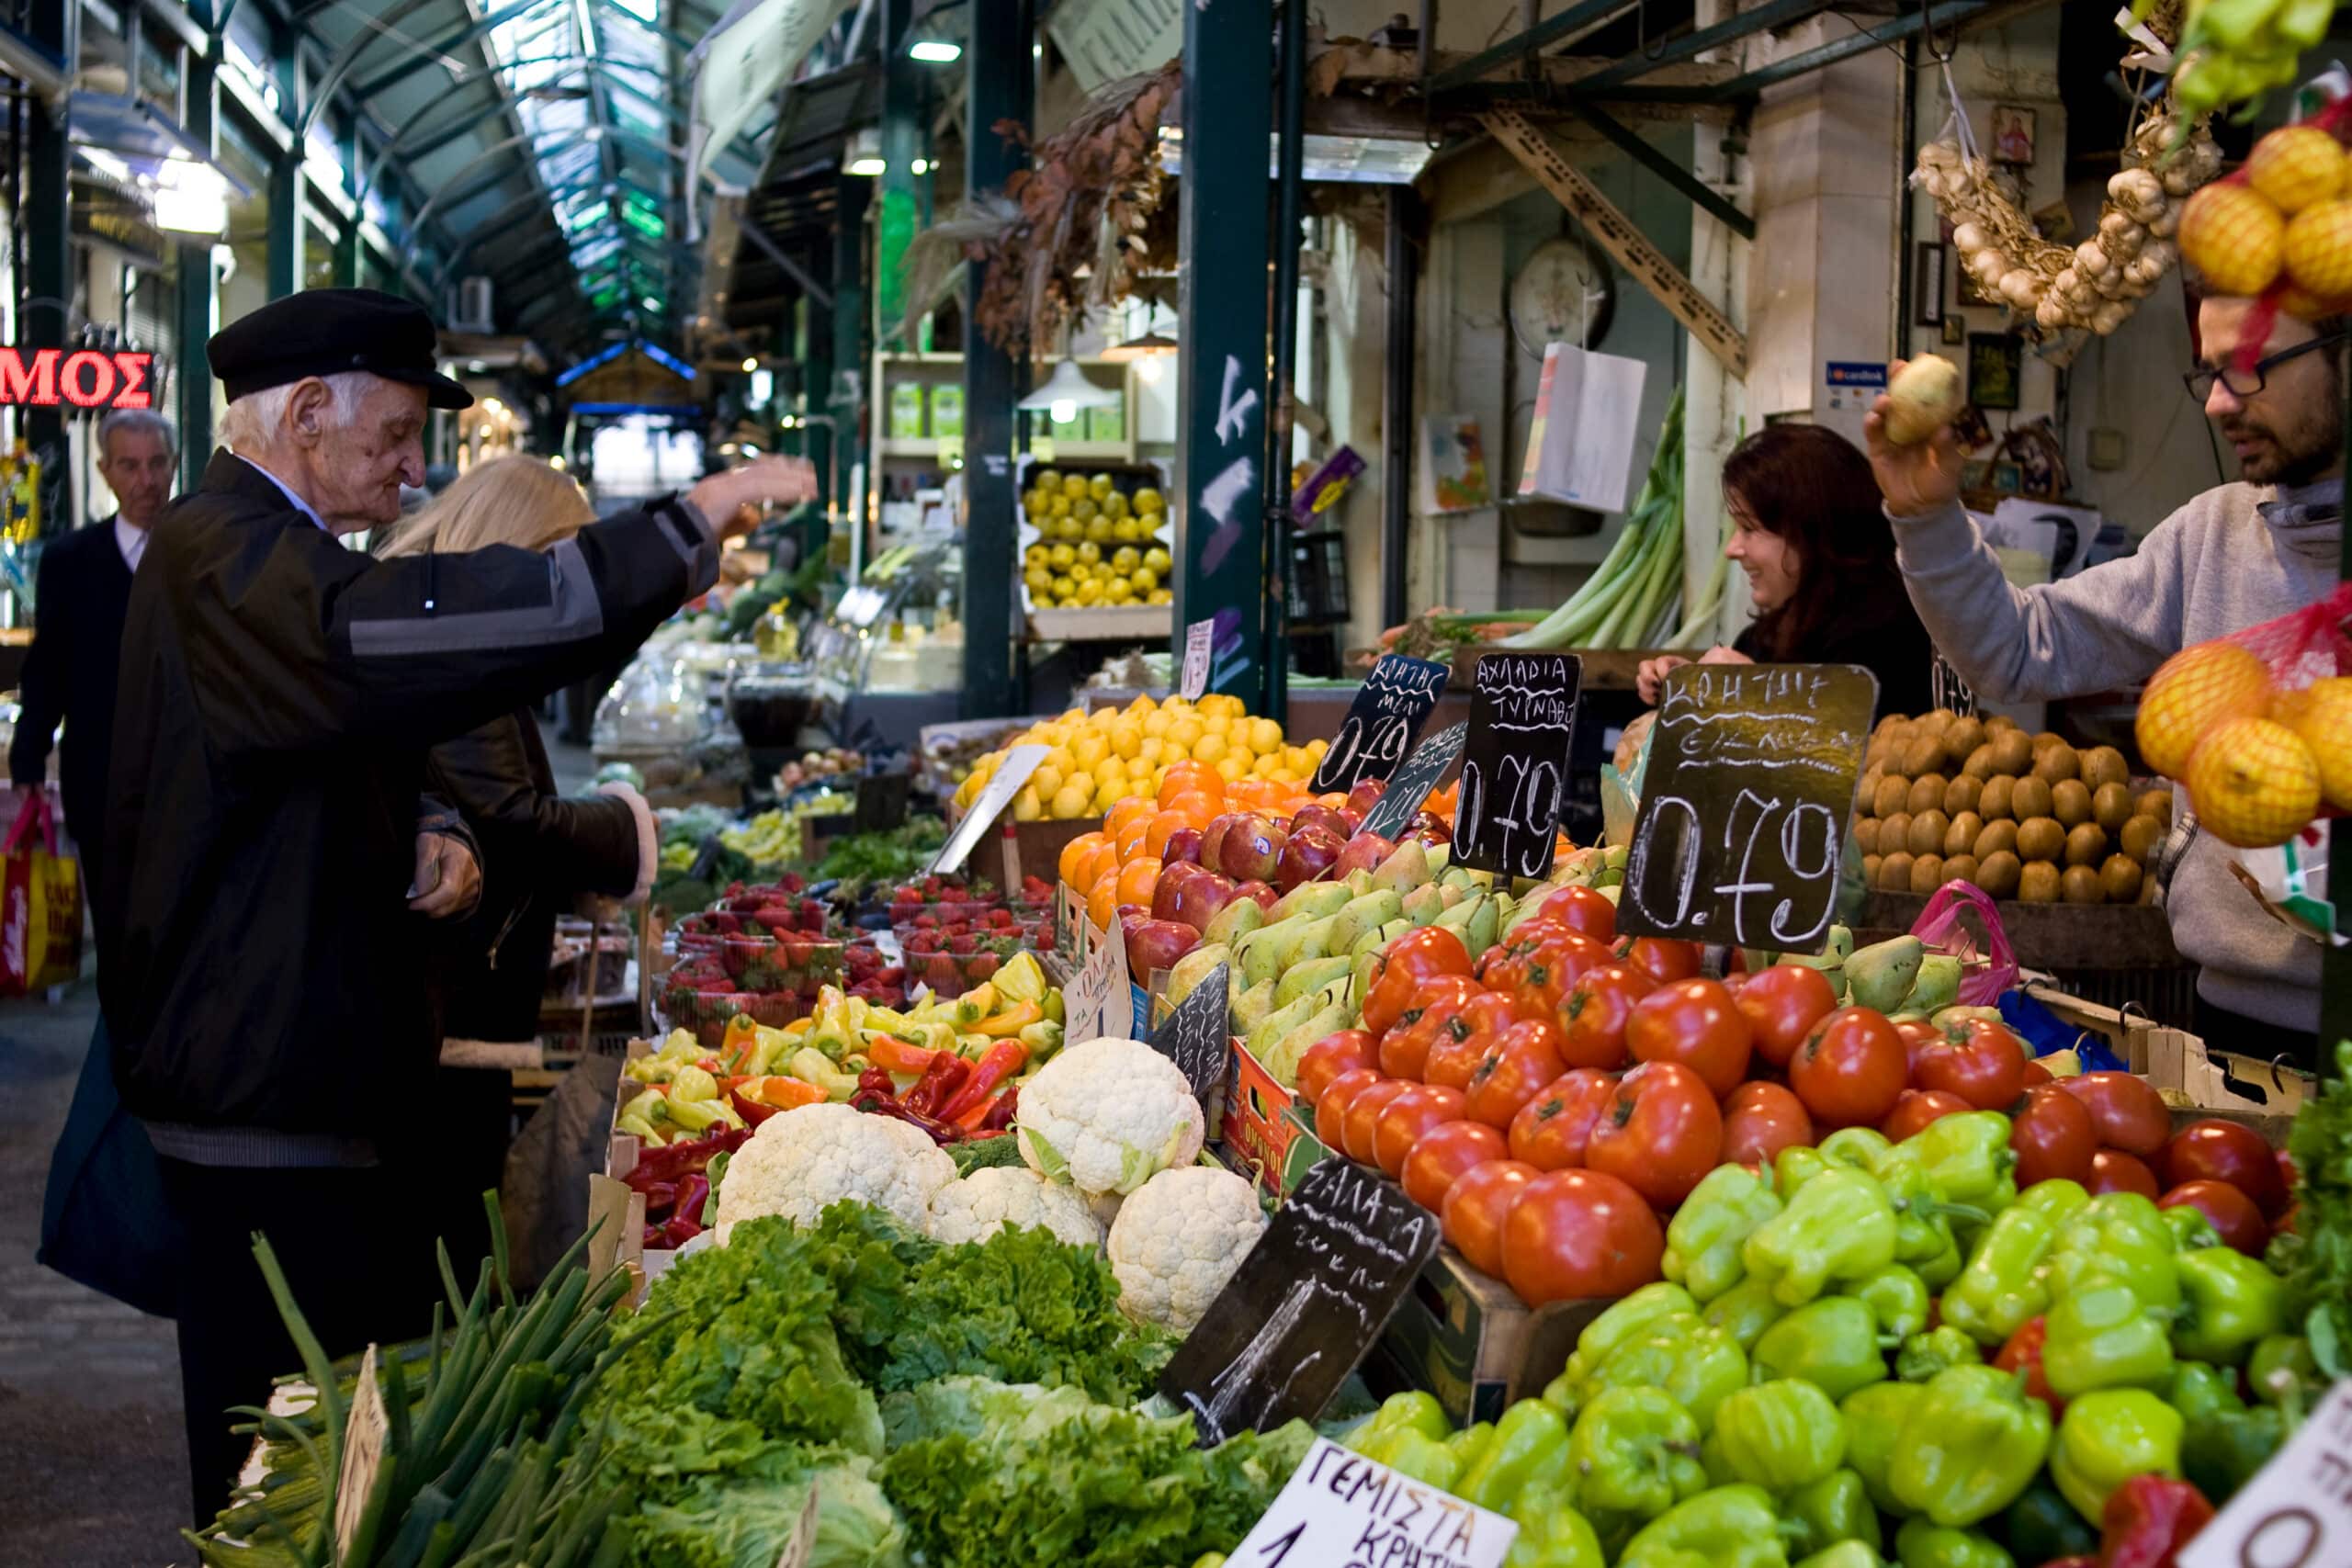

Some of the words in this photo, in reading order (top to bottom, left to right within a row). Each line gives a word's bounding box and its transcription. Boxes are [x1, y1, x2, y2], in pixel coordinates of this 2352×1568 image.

[0, 347, 152, 409] ΜΟΣ
[1303, 1158, 1424, 1257] ΣΑΛΑΤΑ
[1308, 1446, 1477, 1556] ΓΕΜΙΣΤΑ
